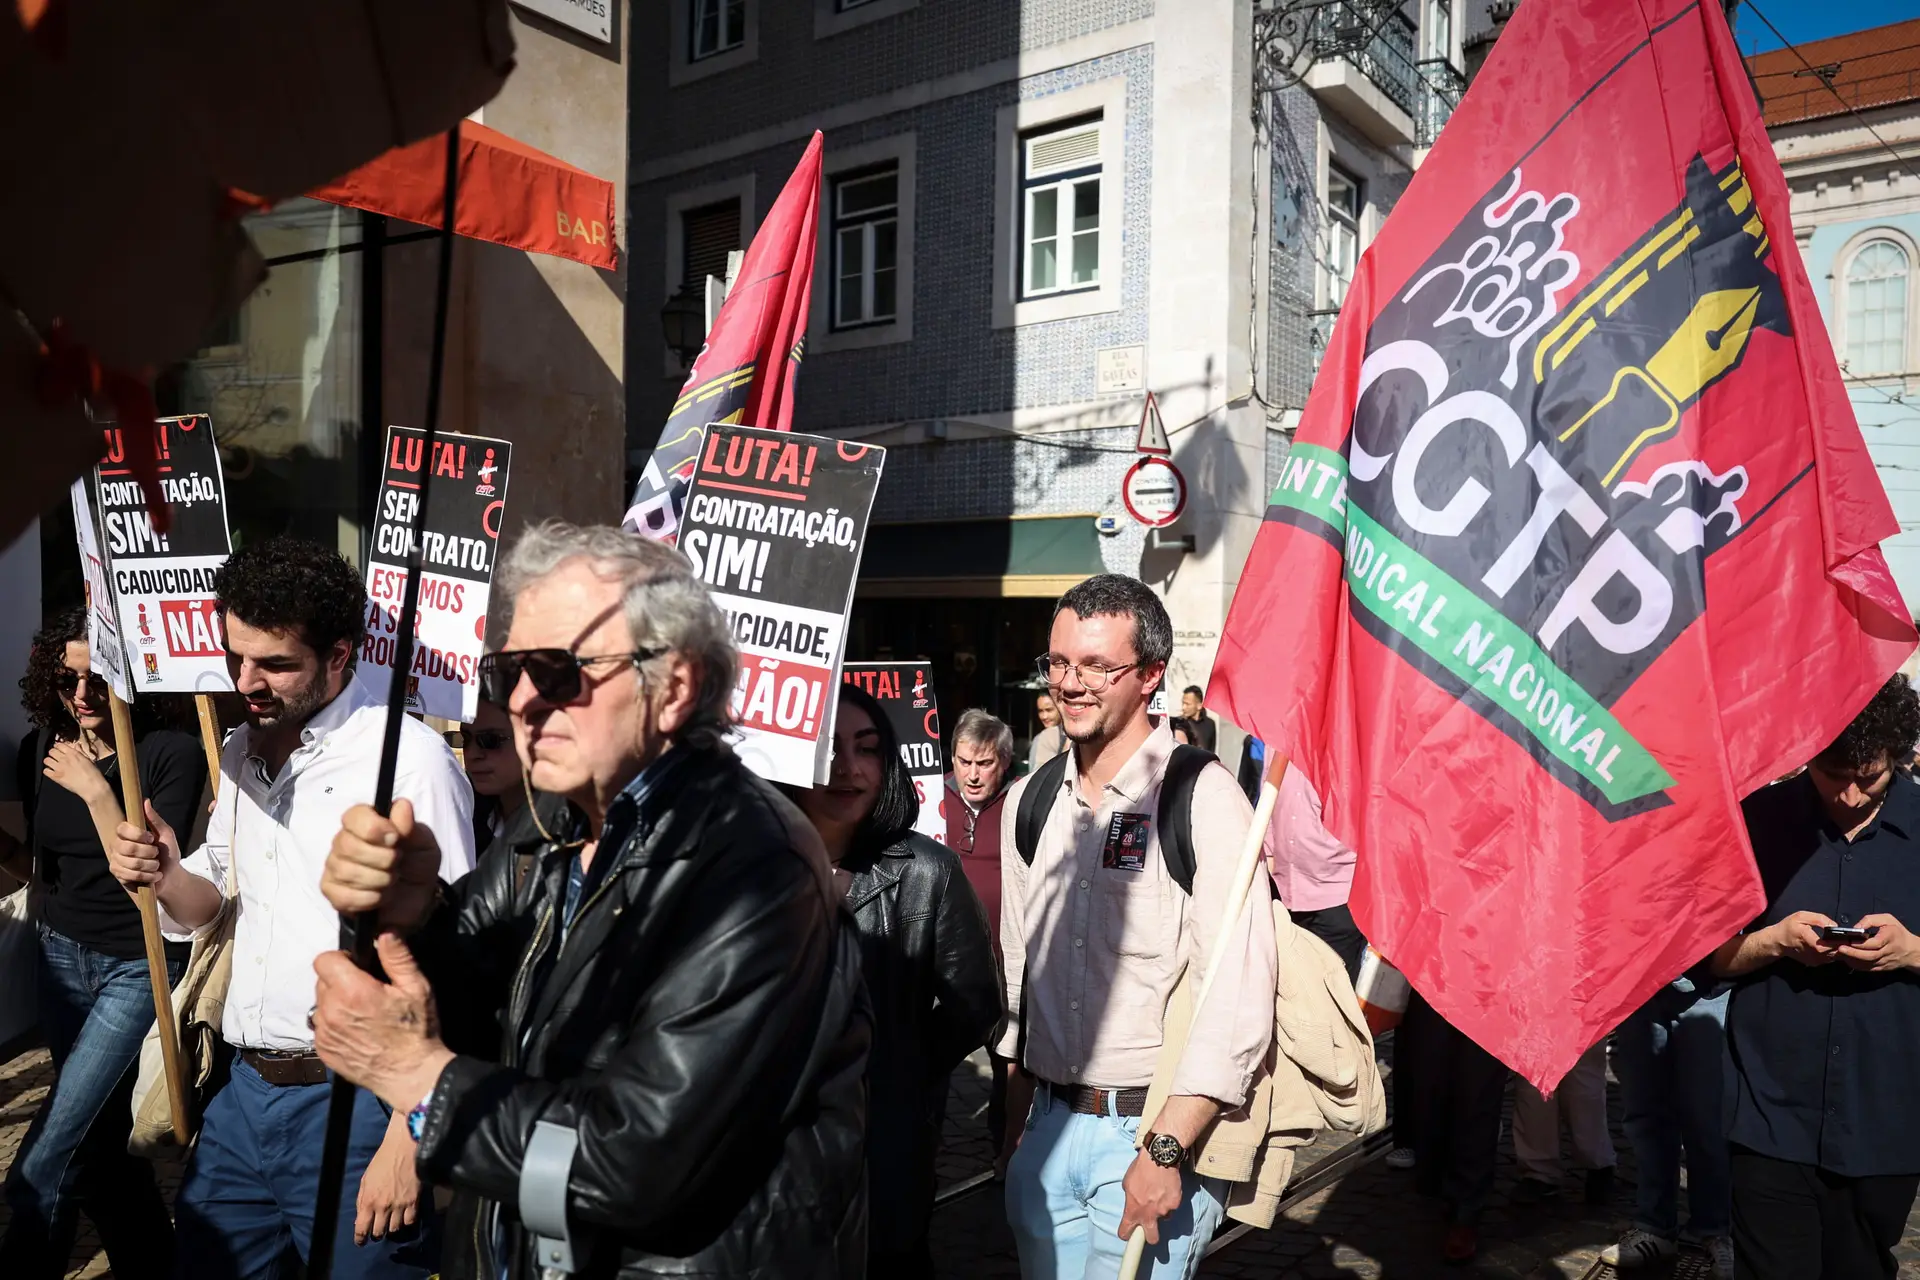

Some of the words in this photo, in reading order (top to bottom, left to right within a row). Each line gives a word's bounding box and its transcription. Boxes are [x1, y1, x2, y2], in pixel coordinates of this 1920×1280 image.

[556, 210, 607, 248] BAR
[390, 436, 467, 479] LUTA!
[702, 432, 817, 487] LUTA!
[101, 472, 219, 507] CONTTAÇÃO,
[1349, 339, 1674, 655] CGTP
[690, 494, 857, 553] CONTRATAÇÃO,
[116, 567, 222, 595] CADUCIDAD
[684, 530, 771, 593] SIM!
[372, 568, 465, 614] ESTMOS
[367, 601, 380, 631] A
[385, 604, 422, 640] SR
[722, 608, 830, 665] CIDADE,
[362, 633, 479, 686] ROUADOS!
[1454, 621, 1628, 784] NACIONAL
